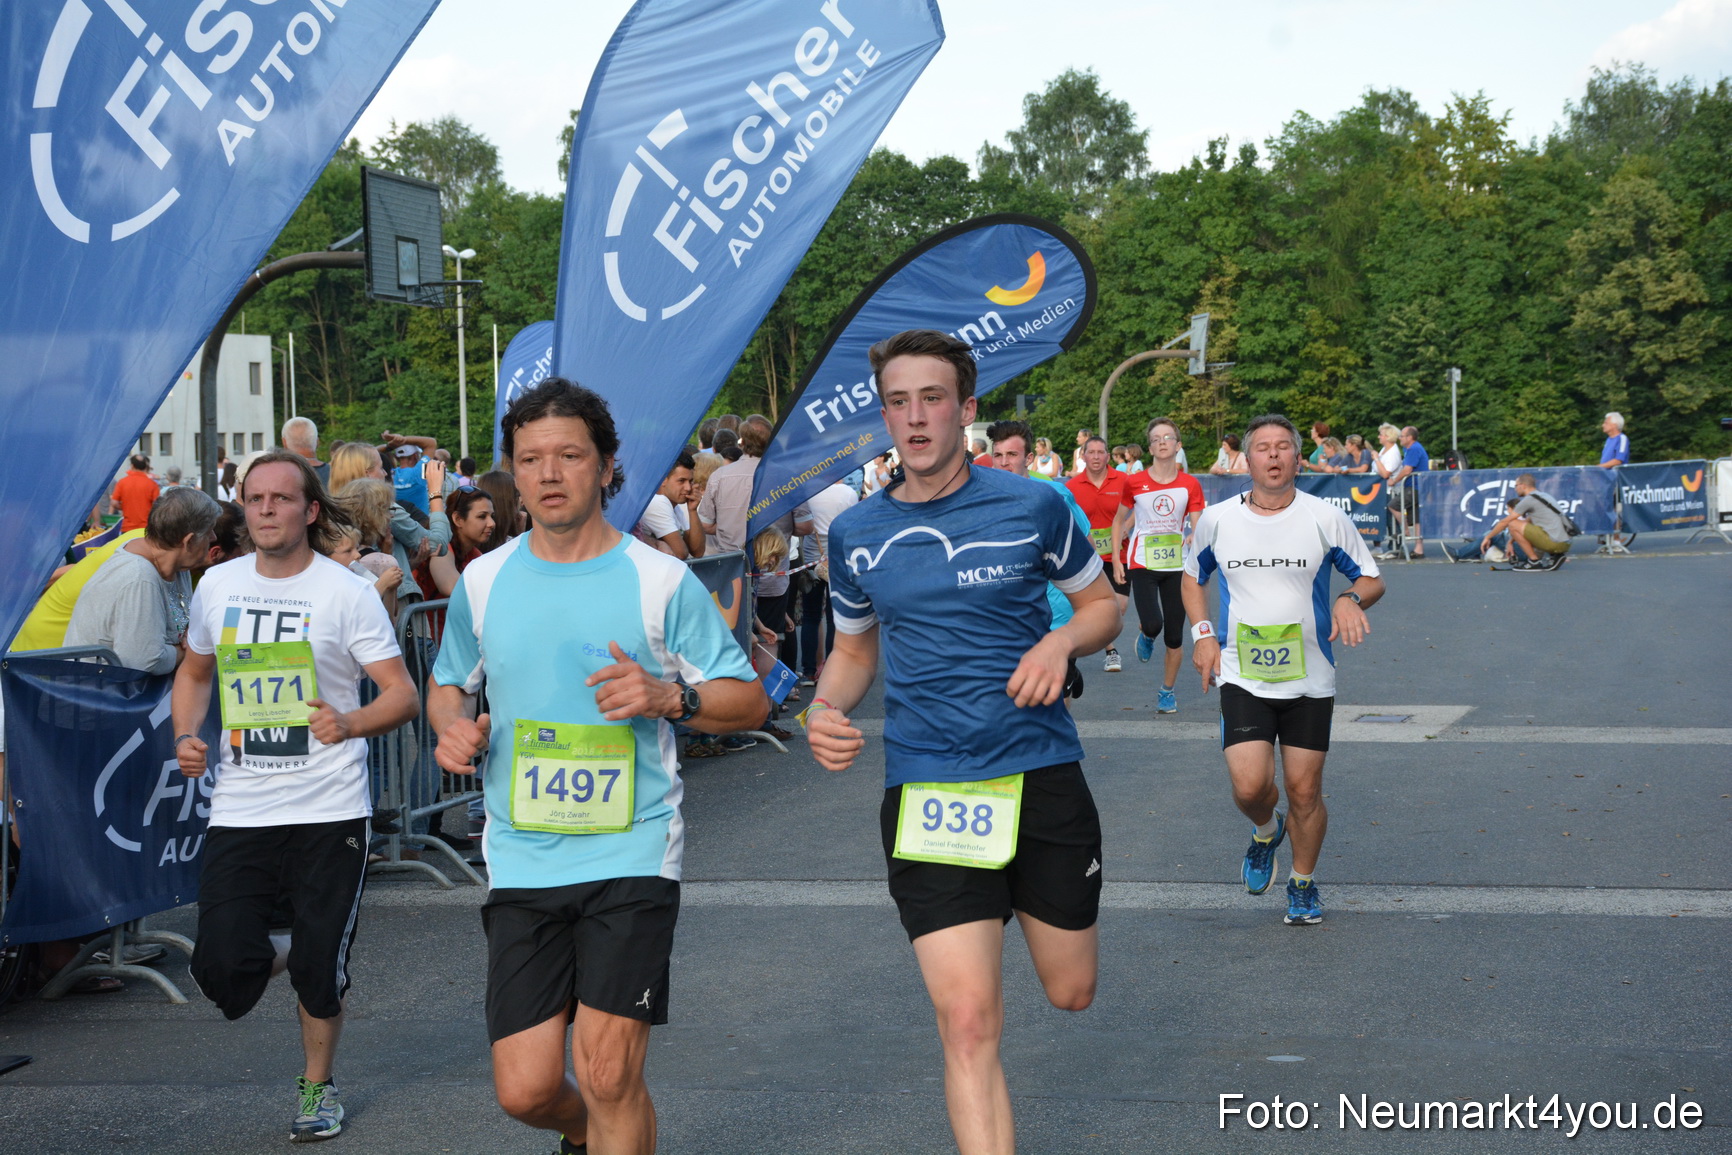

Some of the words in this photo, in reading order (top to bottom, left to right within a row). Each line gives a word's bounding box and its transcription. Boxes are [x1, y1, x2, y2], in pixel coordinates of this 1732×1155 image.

[653, 0, 856, 273] Fischer
[727, 38, 881, 268] AUTOMOBILE
[985, 331, 1019, 354] und
[1016, 298, 1076, 339] Medien
[1621, 483, 1685, 504] Frischmann
[1153, 548, 1176, 560] 534
[1227, 558, 1307, 569] DELPHI
[957, 565, 1004, 584] MCM
[243, 595, 261, 603] NEUE
[263, 598, 313, 608] WOHNFORMEL
[595, 648, 638, 661] suda
[1250, 647, 1291, 667] 292
[230, 675, 304, 705] 1171
[245, 759, 309, 770] RAUMWERK
[524, 765, 621, 803] 1497
[566, 810, 591, 819] Zwahr
[922, 798, 993, 837] 938
[923, 839, 946, 848] Daniel
[946, 840, 987, 852] Federhofer
